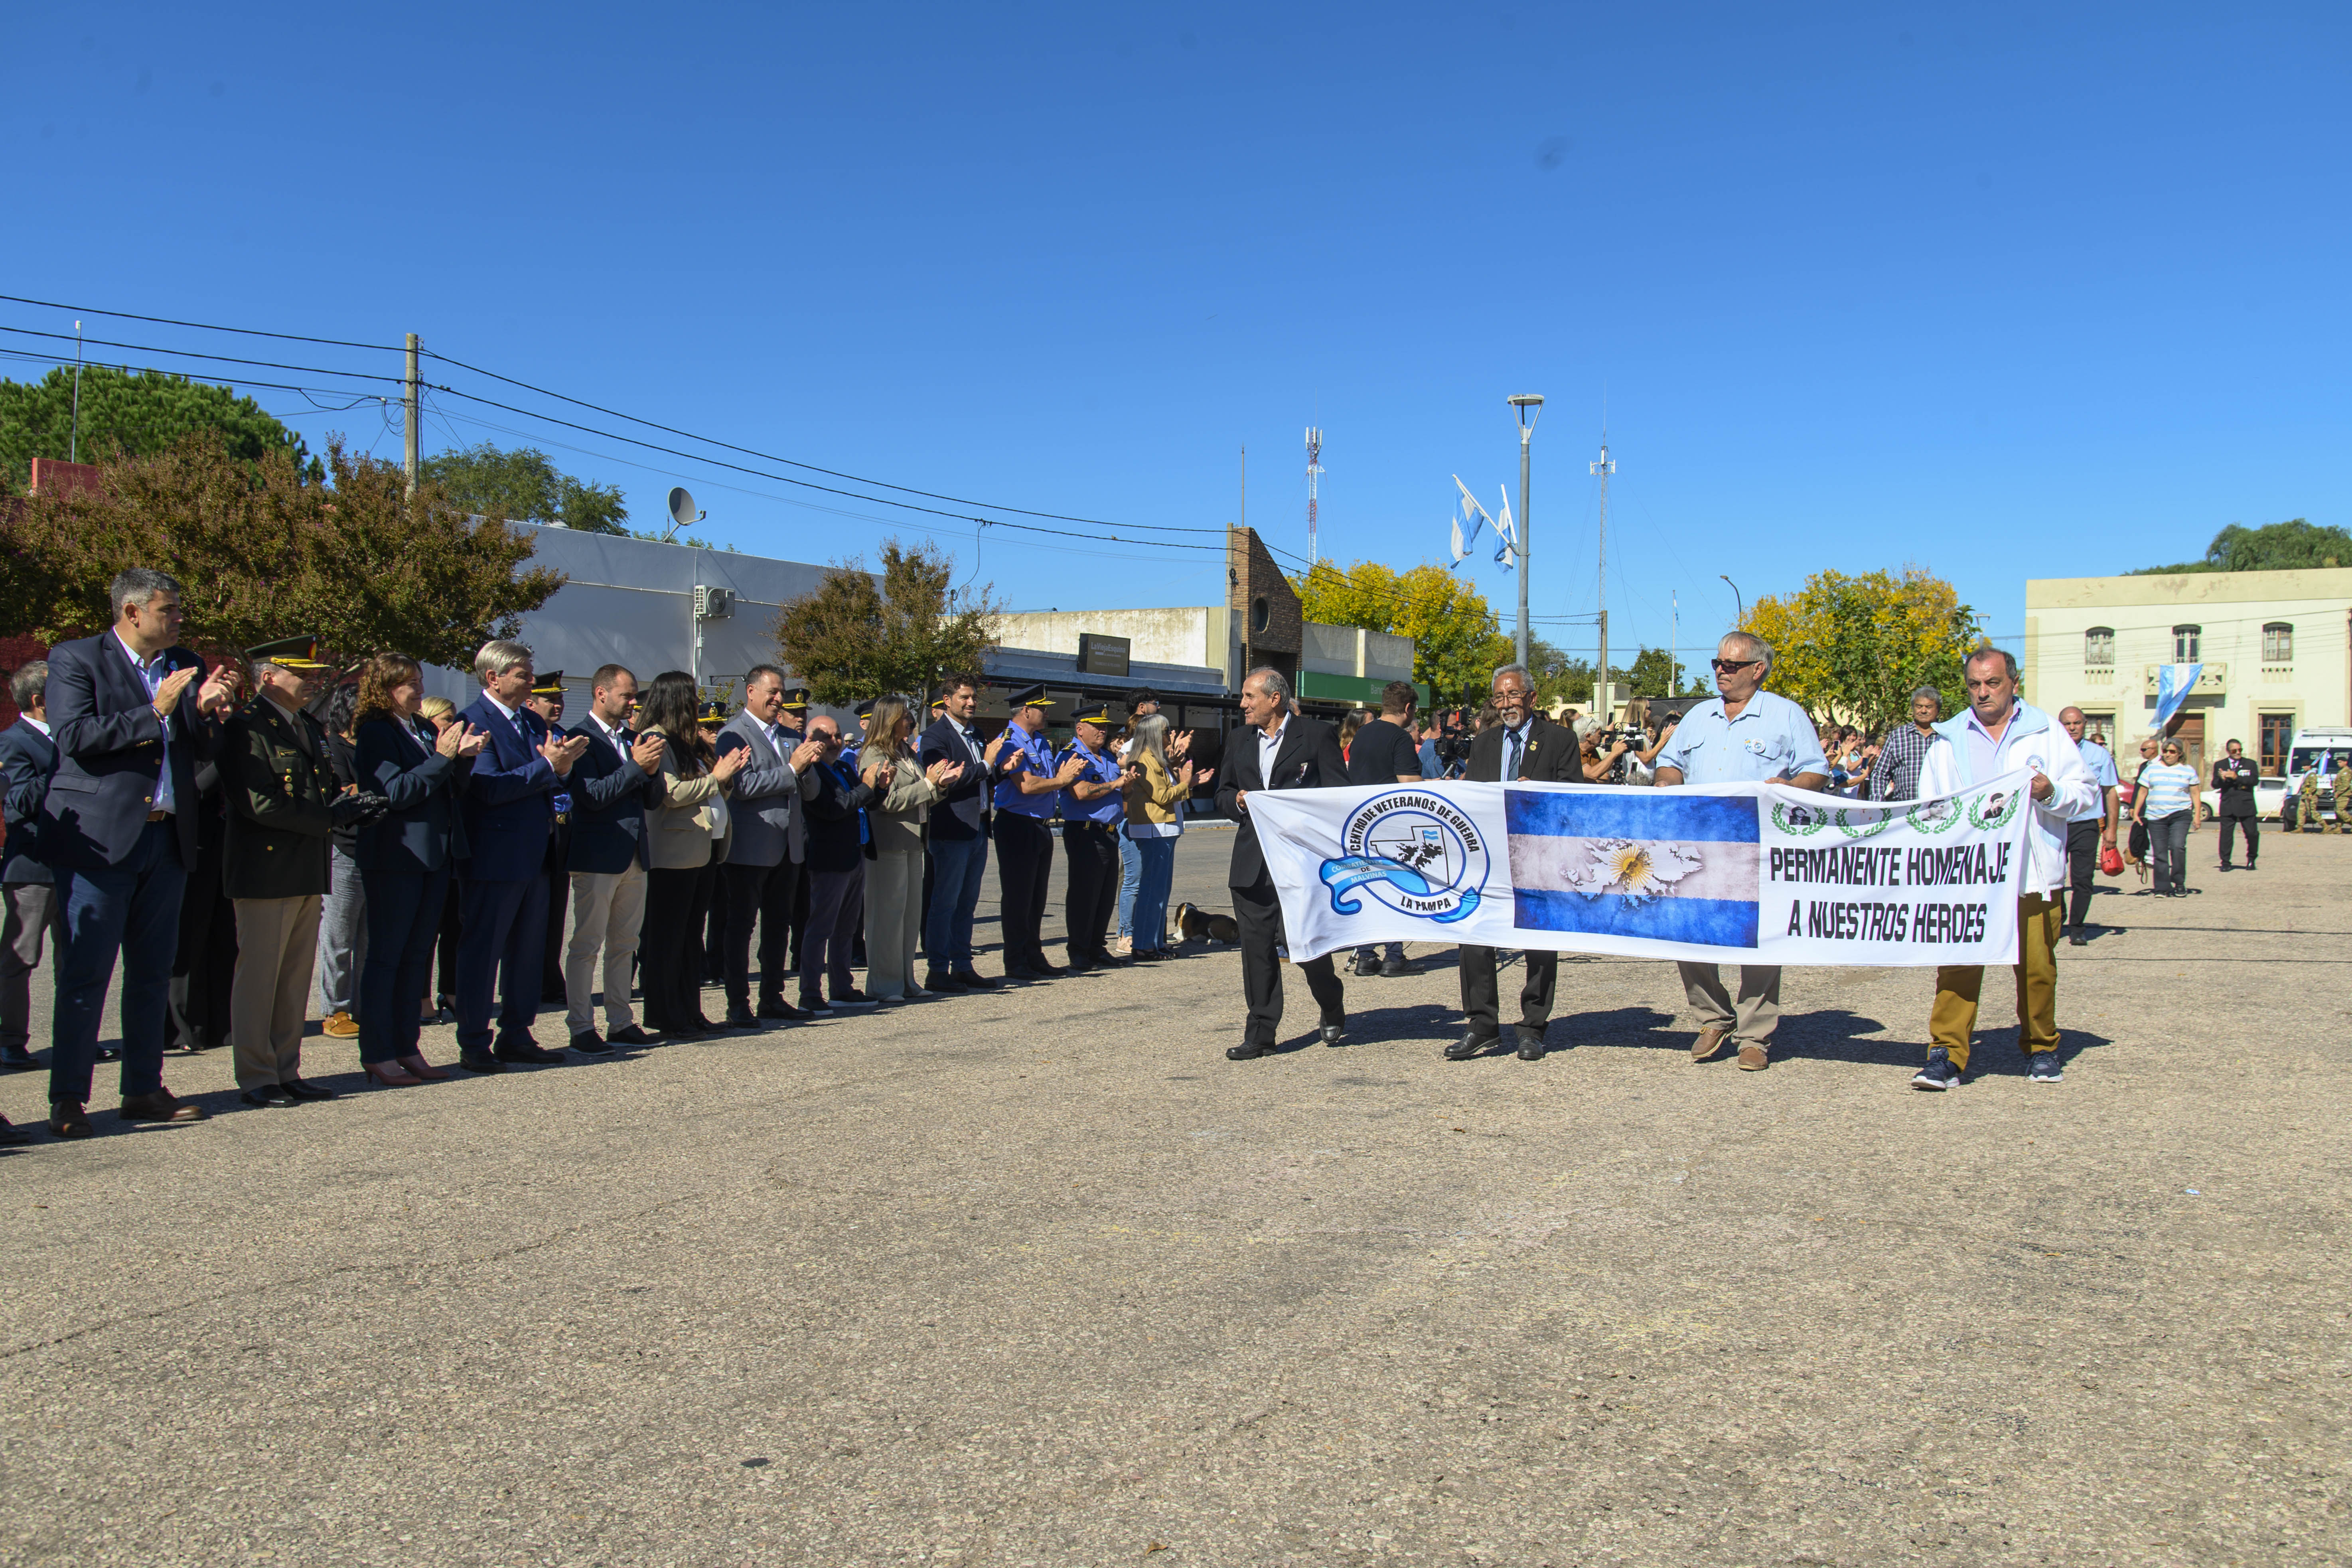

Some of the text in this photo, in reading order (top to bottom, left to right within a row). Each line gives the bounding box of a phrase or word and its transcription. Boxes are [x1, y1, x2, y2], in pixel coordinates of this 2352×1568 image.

[1371, 684, 1384, 695] Banc
[1350, 796, 1480, 852] CENTRO DE VETERANOS DE GUERRA
[1351, 871, 1387, 883] MALVINAS
[1770, 842, 2011, 886] PERMANENTE HOMENAJE
[1400, 896, 1451, 911] LA PAMPA
[1788, 899, 1987, 943] A NUESTROS HEROES
